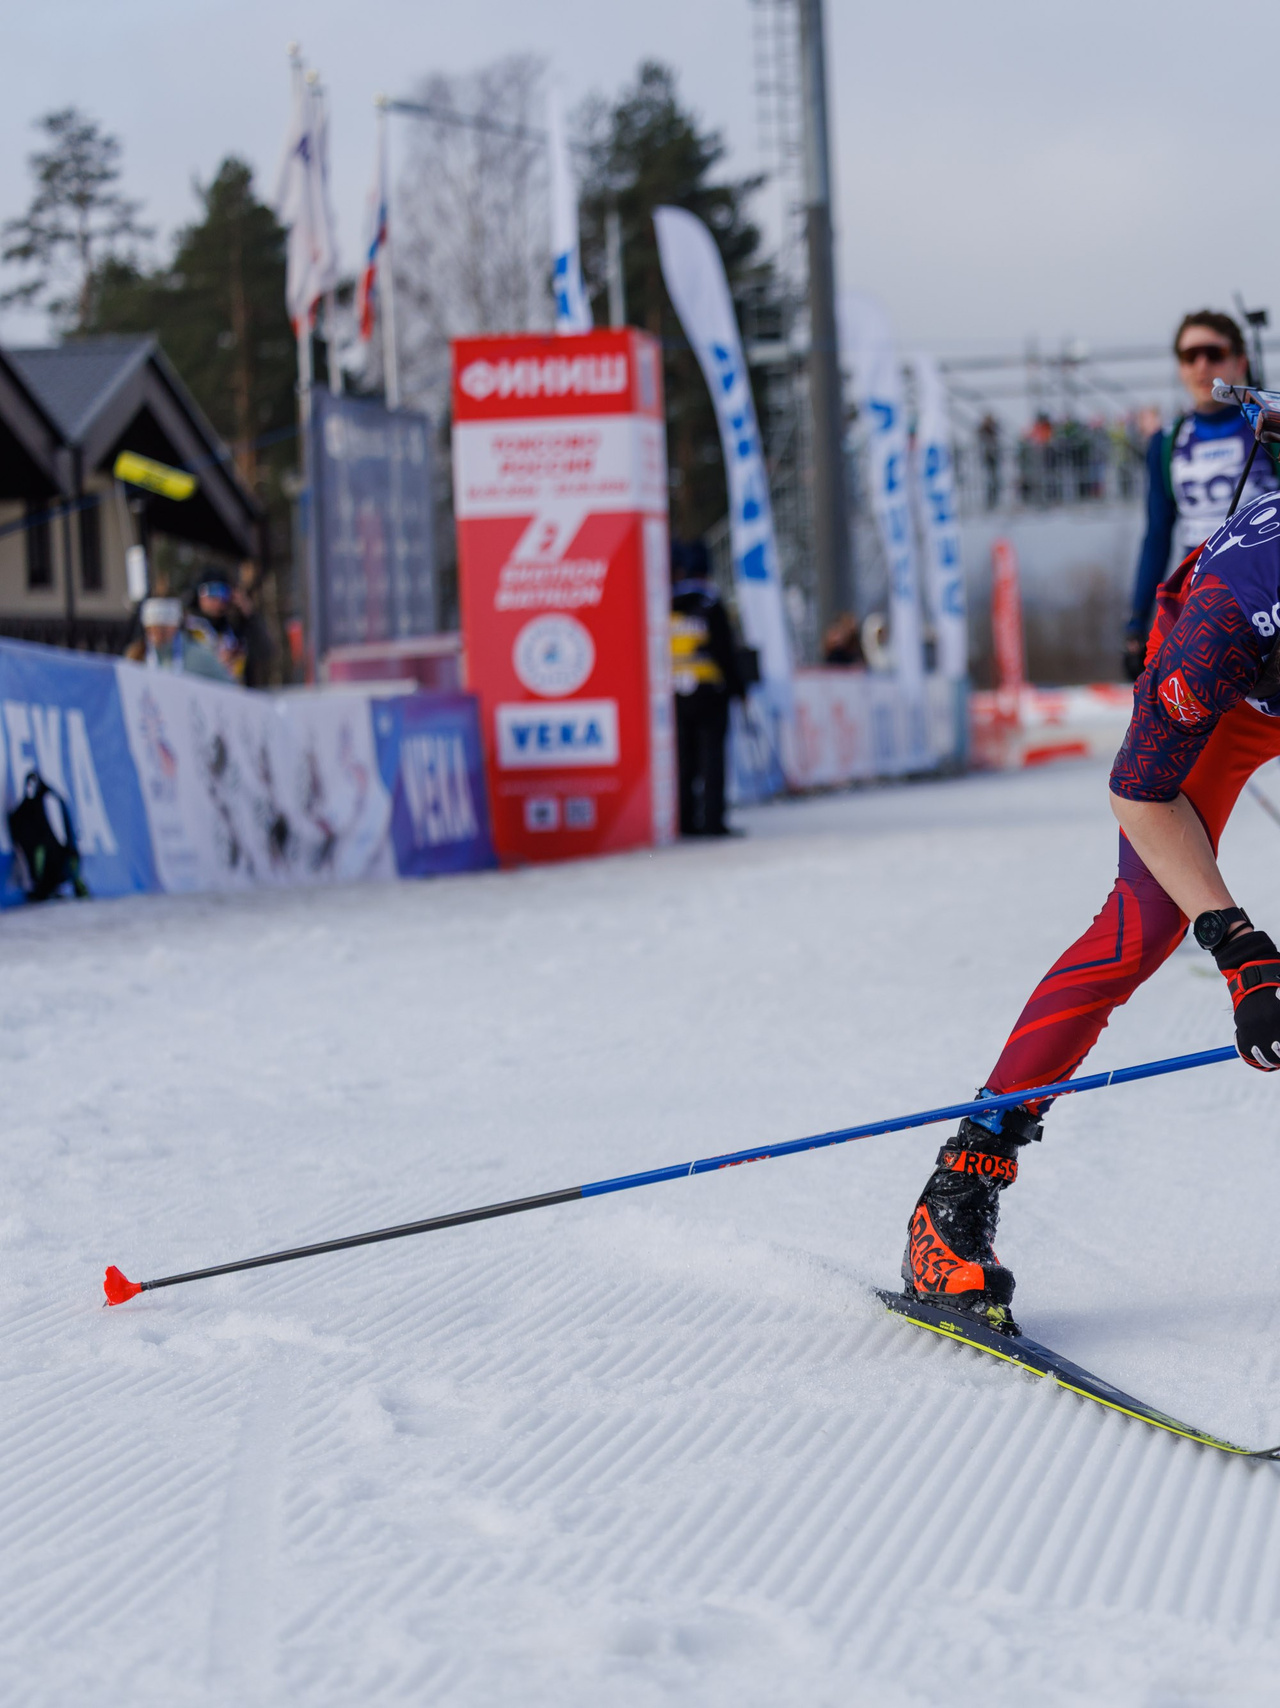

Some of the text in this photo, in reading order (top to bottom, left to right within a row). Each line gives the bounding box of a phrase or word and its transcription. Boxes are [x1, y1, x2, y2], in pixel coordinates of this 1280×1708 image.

[460, 354, 628, 400] ФИНИШ
[512, 720, 604, 751] VEKA
[0, 703, 118, 856] EKA
[963, 1152, 1016, 1181] ROSS
